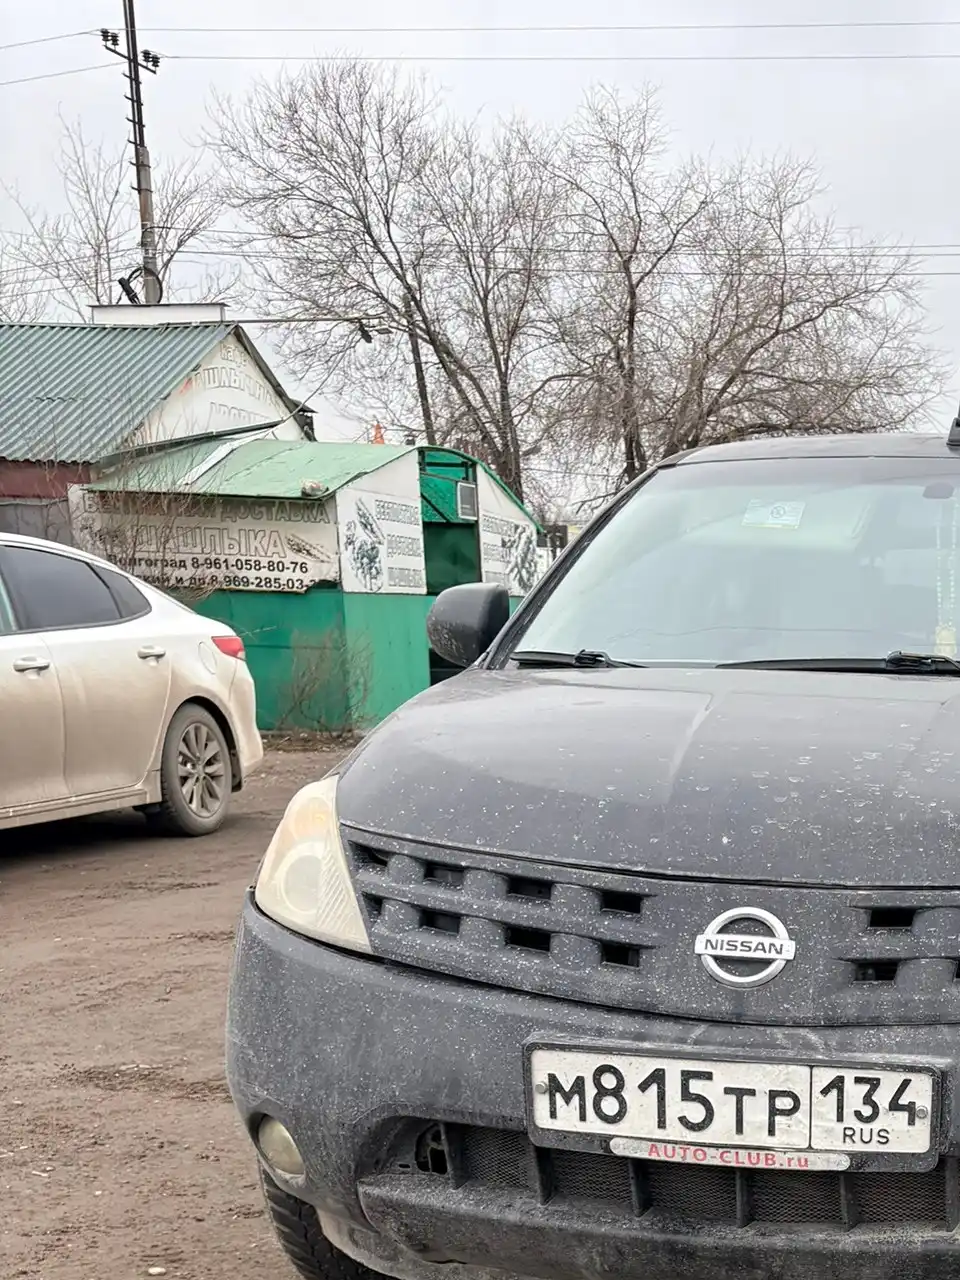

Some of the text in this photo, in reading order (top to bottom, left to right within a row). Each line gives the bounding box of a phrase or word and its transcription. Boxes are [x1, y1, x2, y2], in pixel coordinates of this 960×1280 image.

[220, 501, 331, 524] ДОСТАВКА
[131, 525, 288, 559] ШАШЛЫКА
[191, 557, 309, 574] 8-961-058-80-76
[704, 938, 784, 955] NISSAN
[818, 1074, 917, 1127] 134
[842, 1126, 891, 1145] RUS
[647, 1143, 809, 1169] AUTO-CLUB.ru
